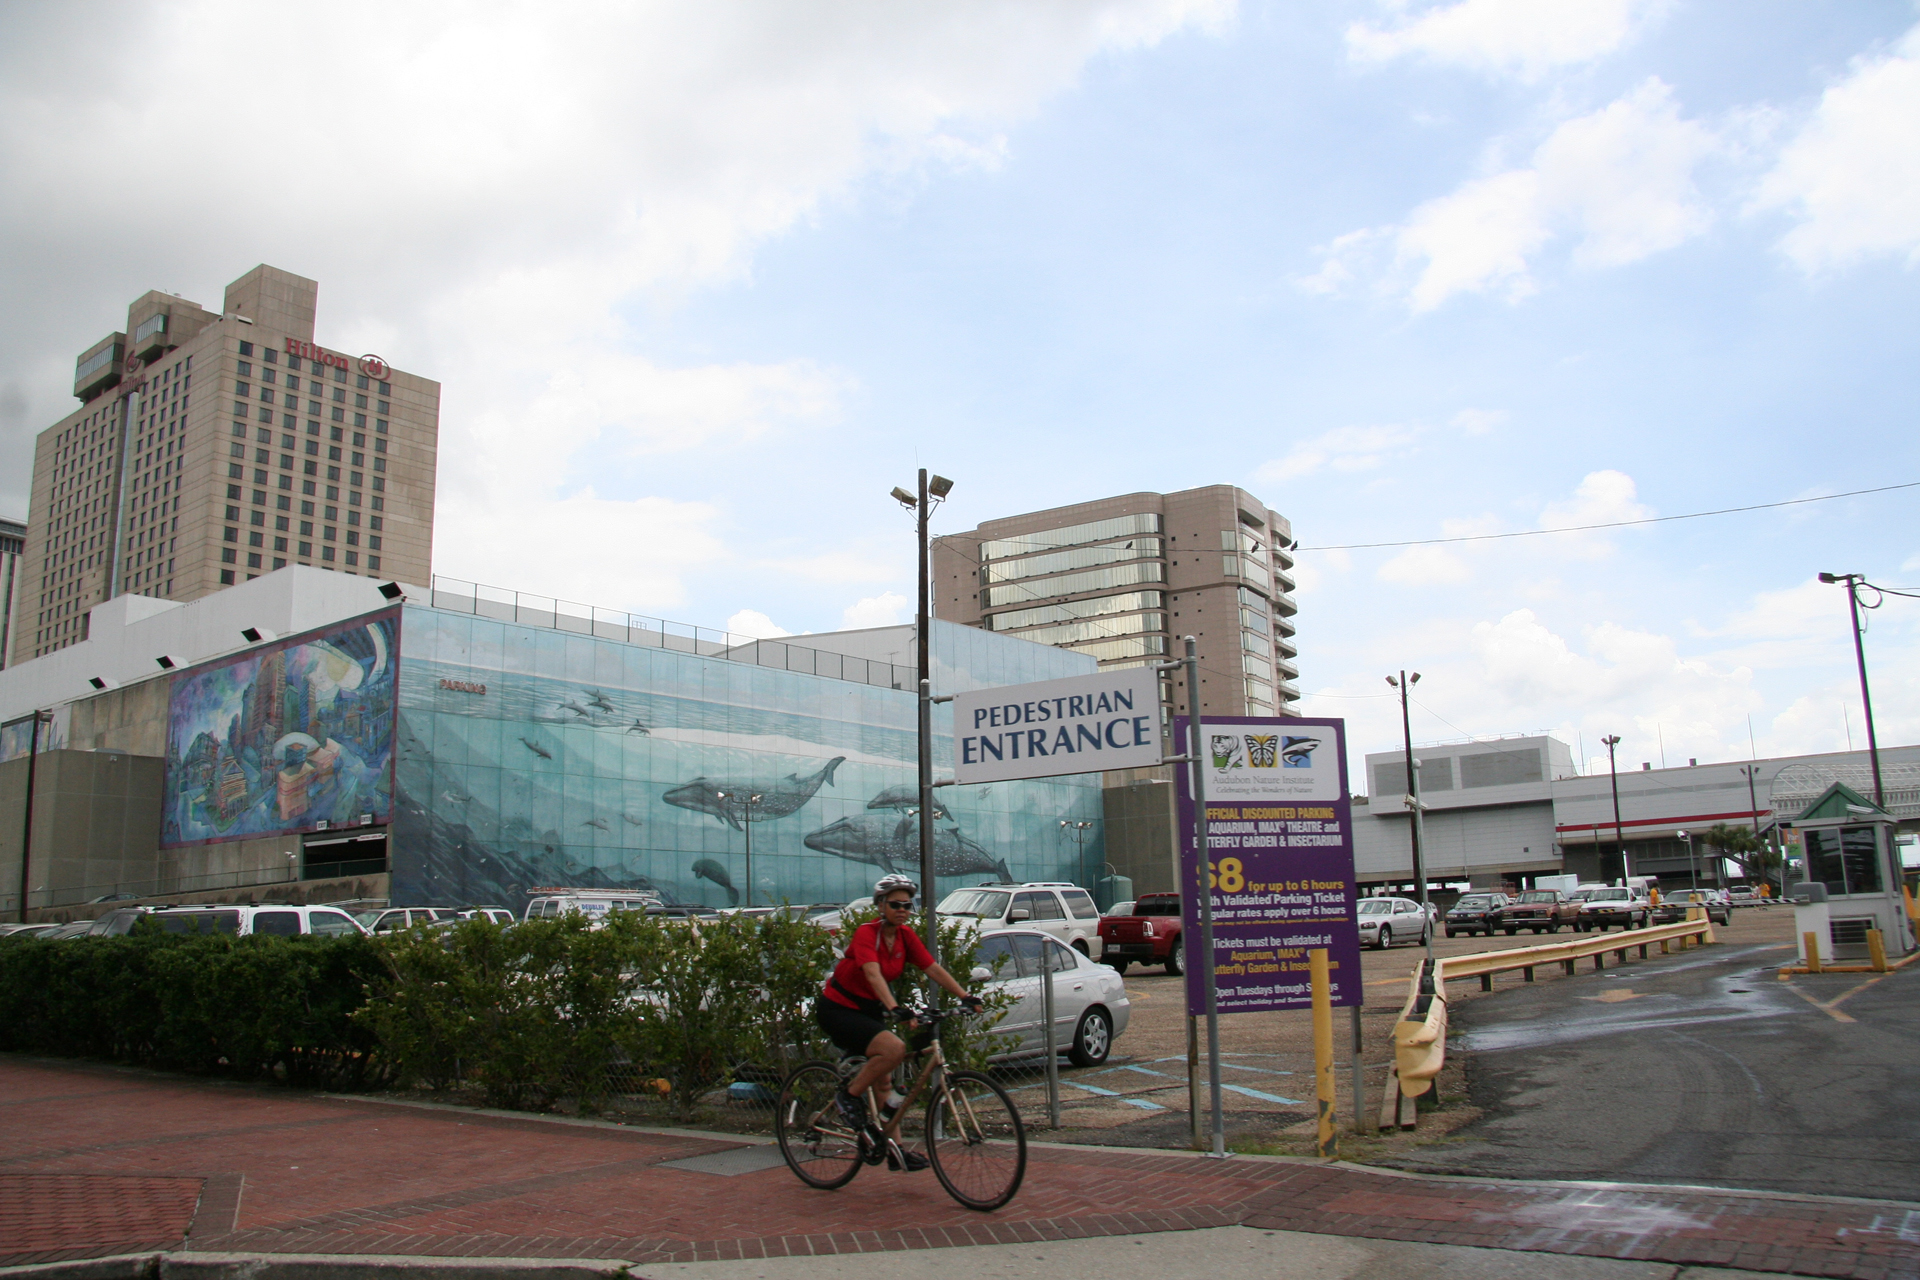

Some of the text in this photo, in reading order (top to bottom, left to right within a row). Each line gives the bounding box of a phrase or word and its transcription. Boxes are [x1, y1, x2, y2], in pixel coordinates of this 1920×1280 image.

[285, 337, 349, 370] Hilton
[439, 679, 486, 695] PARKING
[974, 688, 1133, 729] PEDESTRIAN
[962, 715, 1151, 765] ENTRANCE
[1212, 775, 1315, 785] Audubon Nature Institute
[1216, 786, 1250, 795] Celebrating
[1251, 786, 1261, 794] the
[1262, 786, 1287, 794] Wonders
[1294, 786, 1313, 794] Nature
[1206, 807, 1335, 820] FFICIAL DISCOUNTED PARKING
[1286, 821, 1323, 833] THEATRE
[1324, 821, 1340, 832] and
[1192, 834, 1343, 848] BTTERFLY GARDEN & INSECTARIUM
[1248, 881, 1266, 892] for
[1268, 882, 1284, 893] up
[1286, 880, 1299, 890] to
[1301, 880, 1309, 890] 6
[1311, 880, 1344, 890] hours
[1222, 894, 1272, 906] Validated
[1273, 893, 1312, 905] Parking
[1313, 892, 1345, 903] Ticket
[1237, 908, 1262, 918] rates
[1263, 907, 1289, 918] apply
[1291, 907, 1311, 916] over
[1313, 906, 1319, 915] 6
[1321, 905, 1346, 915] hours
[1212, 934, 1332, 948] Tickets must be validated at
[1214, 963, 1245, 975] utterfly
[1247, 962, 1279, 973] Garden
[1280, 961, 1288, 971] &
[1235, 985, 1273, 996] Tuesdays
[1274, 983, 1304, 994] through
